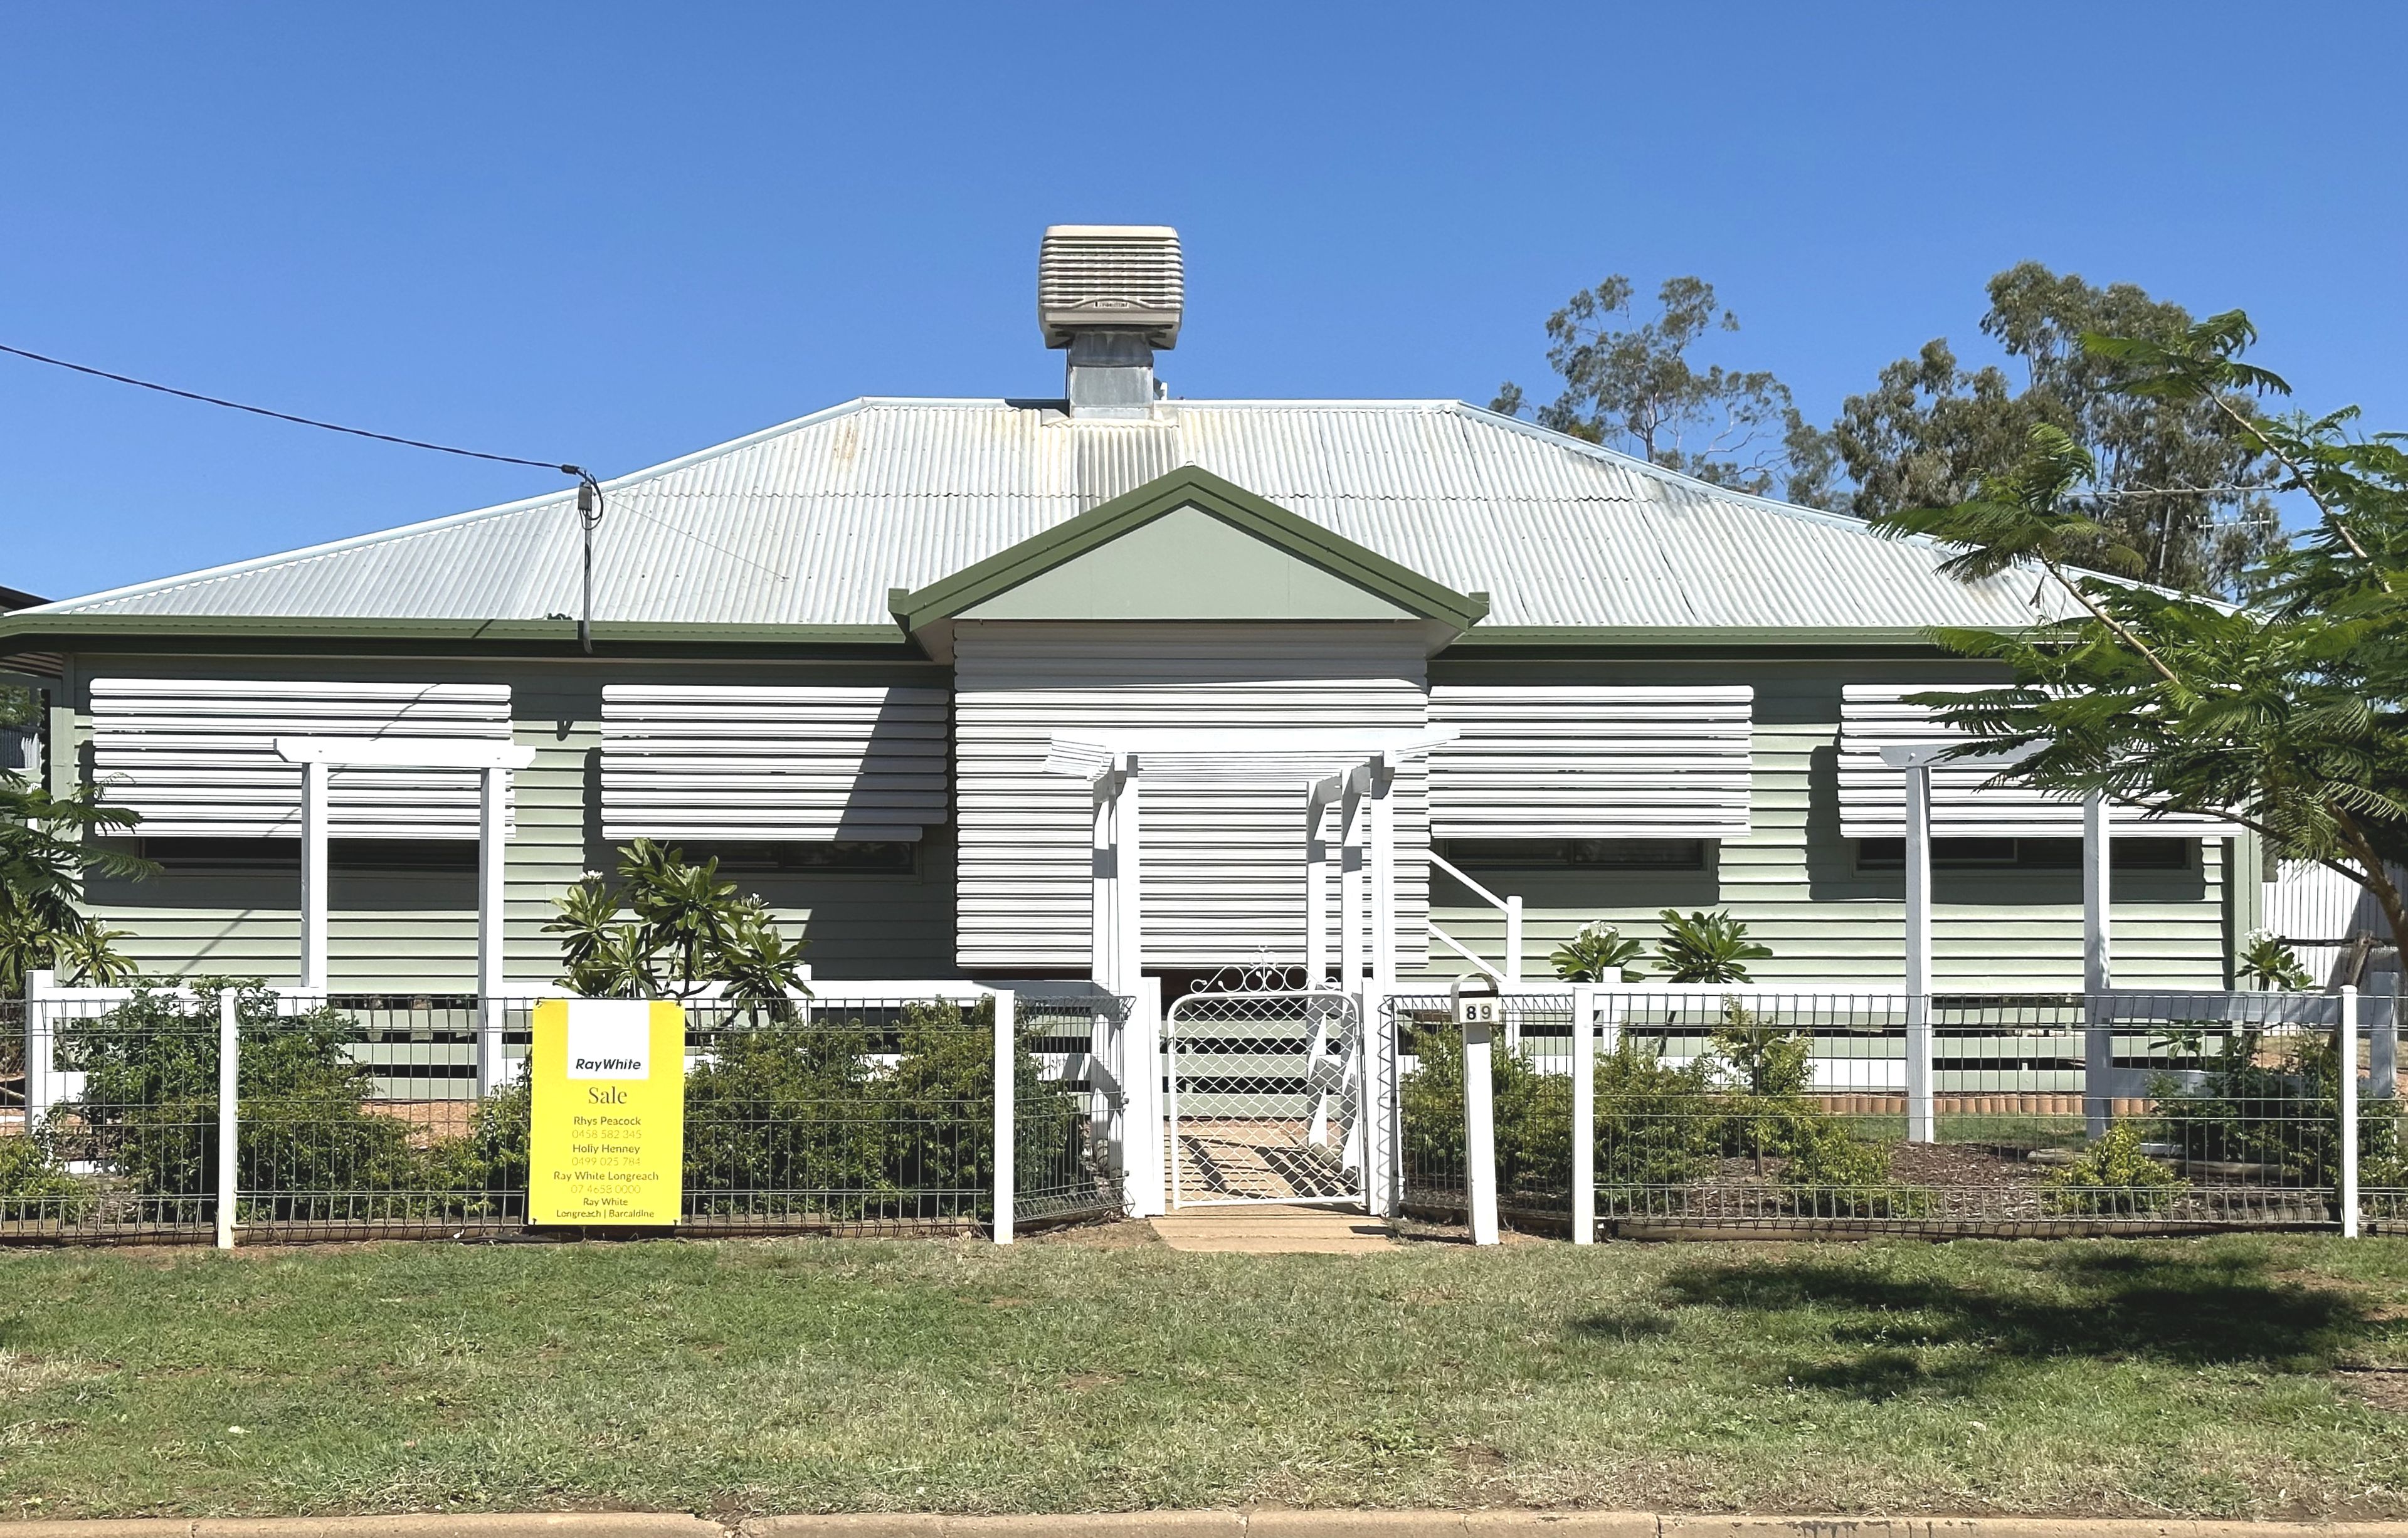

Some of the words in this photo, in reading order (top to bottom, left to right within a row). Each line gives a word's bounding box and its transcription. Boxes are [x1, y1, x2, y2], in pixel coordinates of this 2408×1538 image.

[1466, 1005, 1492, 1021] 89
[588, 1086, 627, 1104] Sale
[574, 1116, 597, 1127] Rhys
[601, 1116, 642, 1125] Peacock
[572, 1129, 598, 1139] 0458
[601, 1129, 620, 1139] 582
[623, 1129, 642, 1139] 345
[573, 1144, 599, 1154] Holly
[601, 1144, 640, 1154] Henney
[572, 1157, 597, 1166] 0499
[600, 1157, 619, 1166] 025
[554, 1171, 572, 1182] Ray
[574, 1171, 605, 1180] White
[608, 1171, 658, 1182] Longreach
[571, 1184, 584, 1194] 07
[615, 1184, 641, 1194] 0000
[583, 1198, 599, 1206] Ray
[556, 1209, 601, 1219] Longreach
[609, 1209, 655, 1218] Barcaldine
